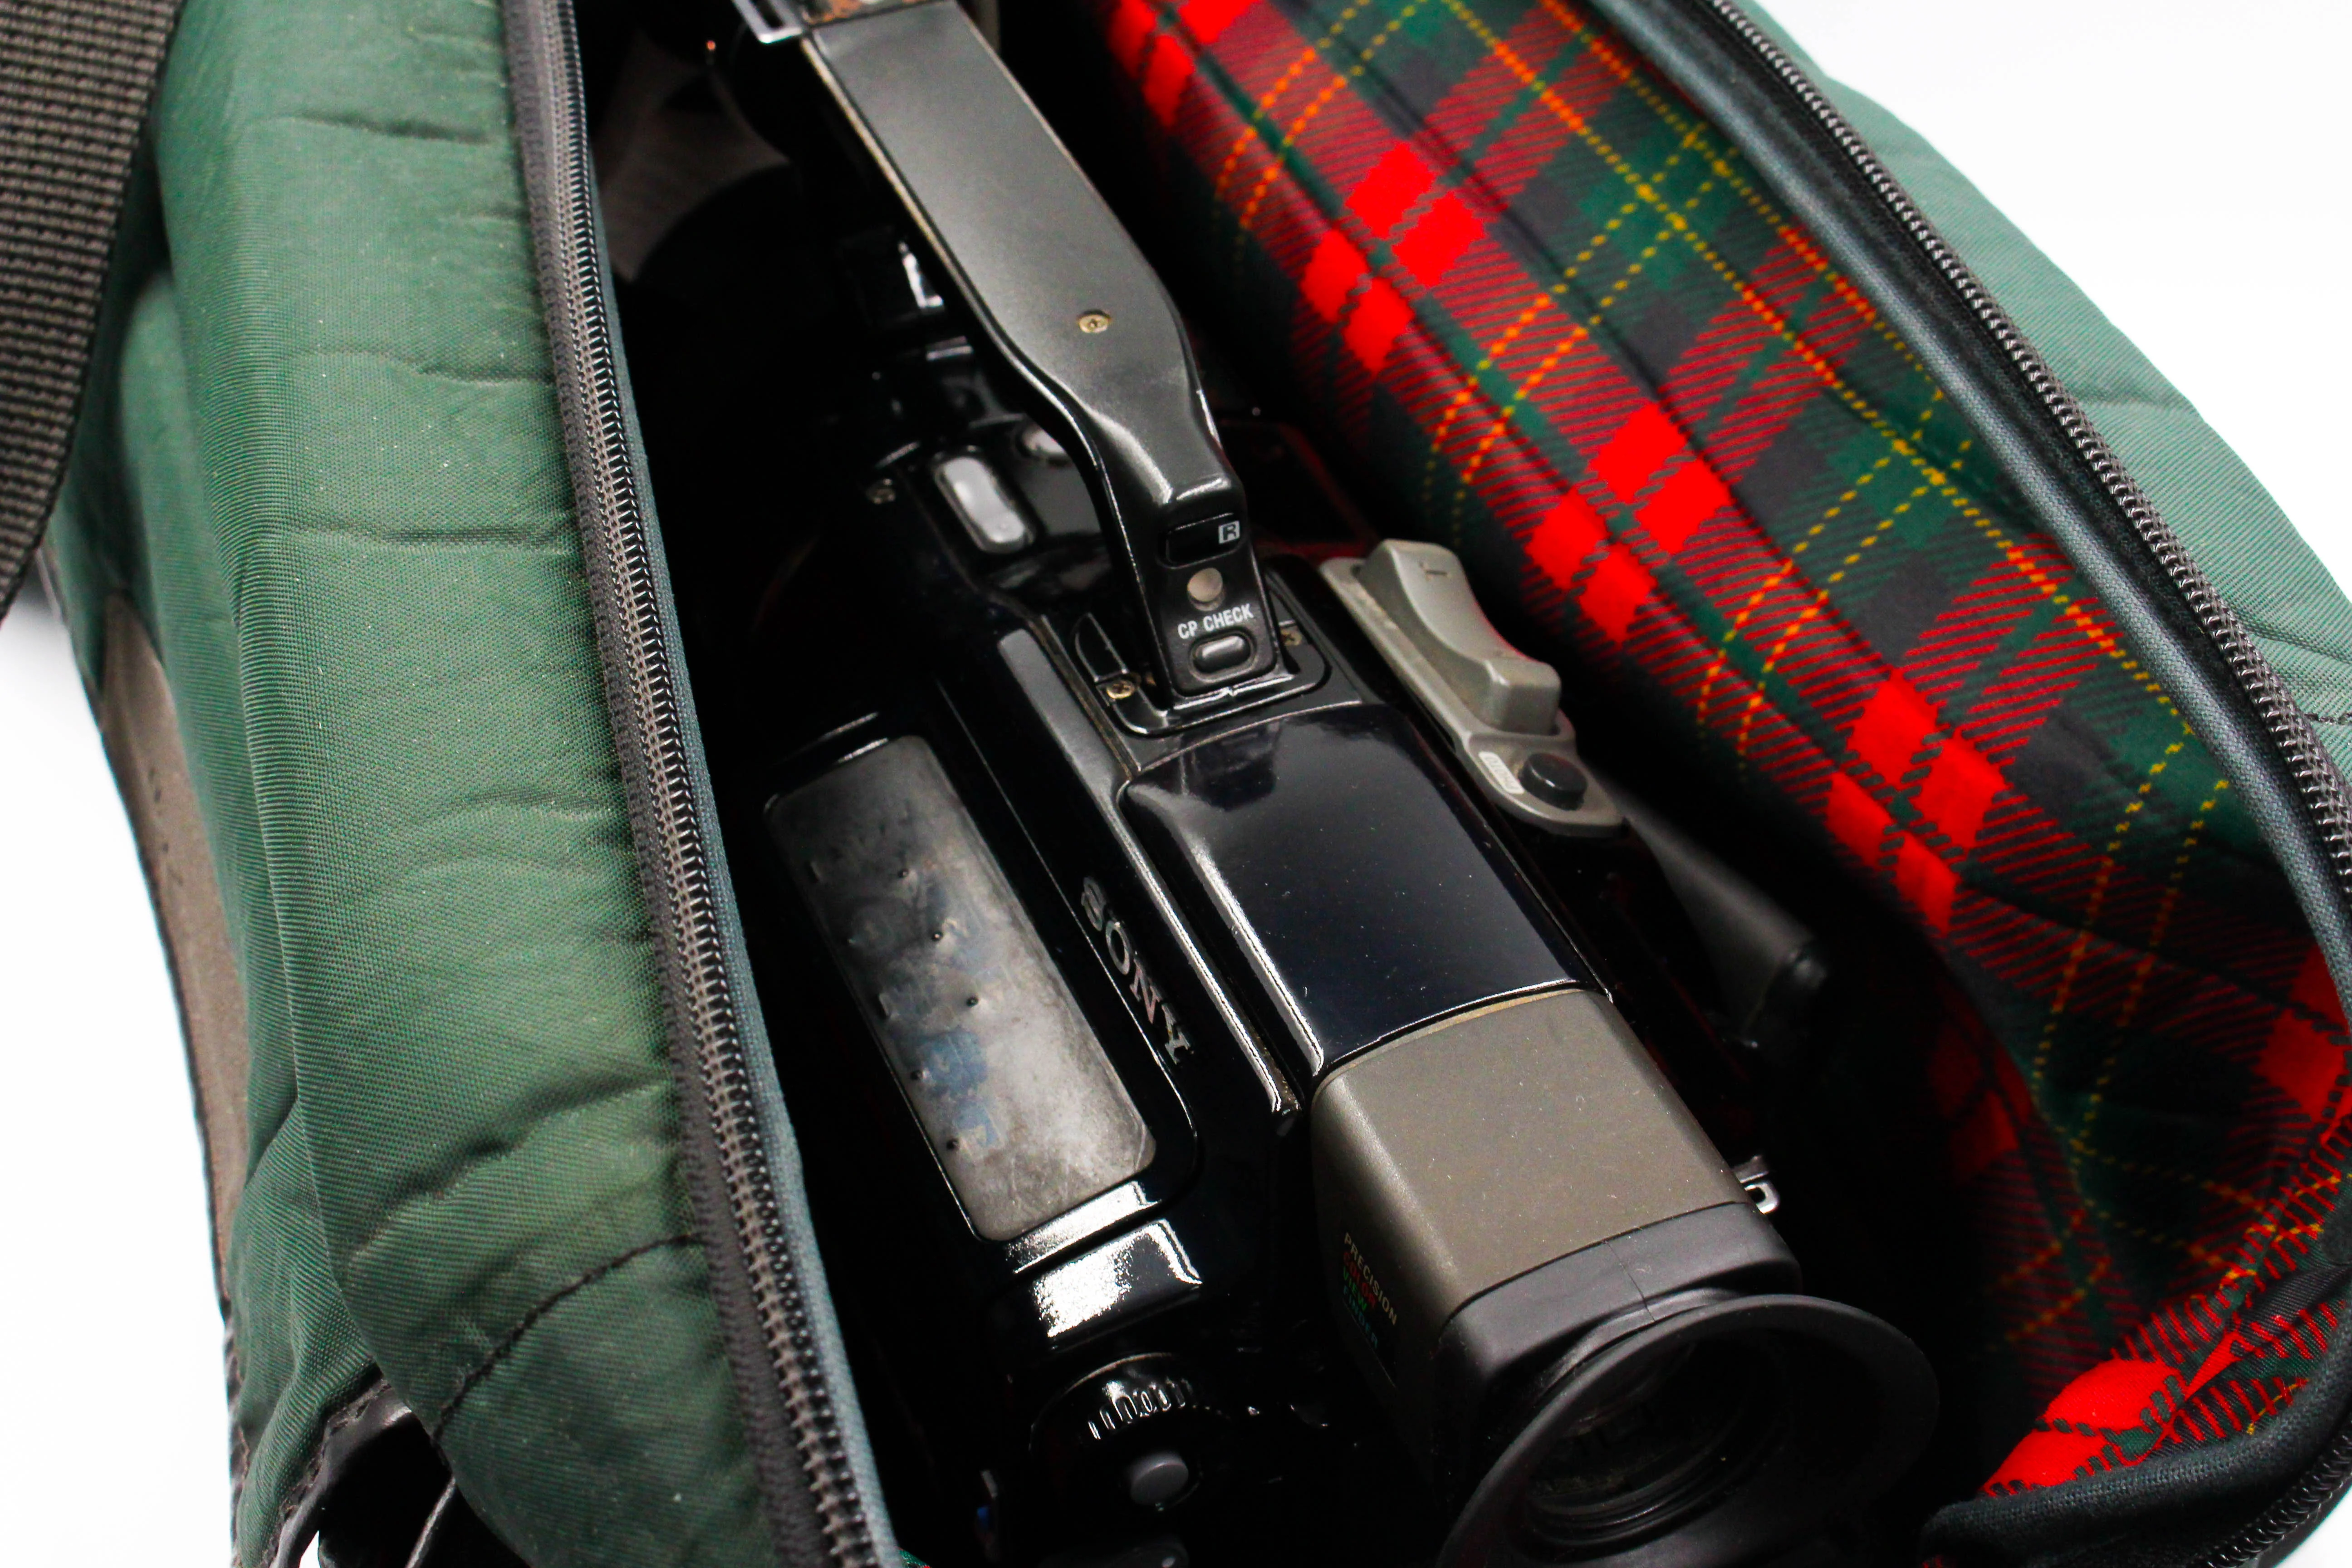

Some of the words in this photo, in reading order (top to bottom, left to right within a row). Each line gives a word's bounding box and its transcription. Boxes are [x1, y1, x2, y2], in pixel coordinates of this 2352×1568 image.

[1221, 522, 1238, 542] R
[1177, 620, 1198, 639] CP
[1203, 604, 1254, 631] CHECK
[1081, 876, 1191, 1064] SONY
[1343, 1251, 1377, 1309] COLOR
[1343, 1266, 1368, 1311] VIEW
[1344, 1232, 1397, 1325] PRECISION
[1343, 1285, 1378, 1348] FINDER
